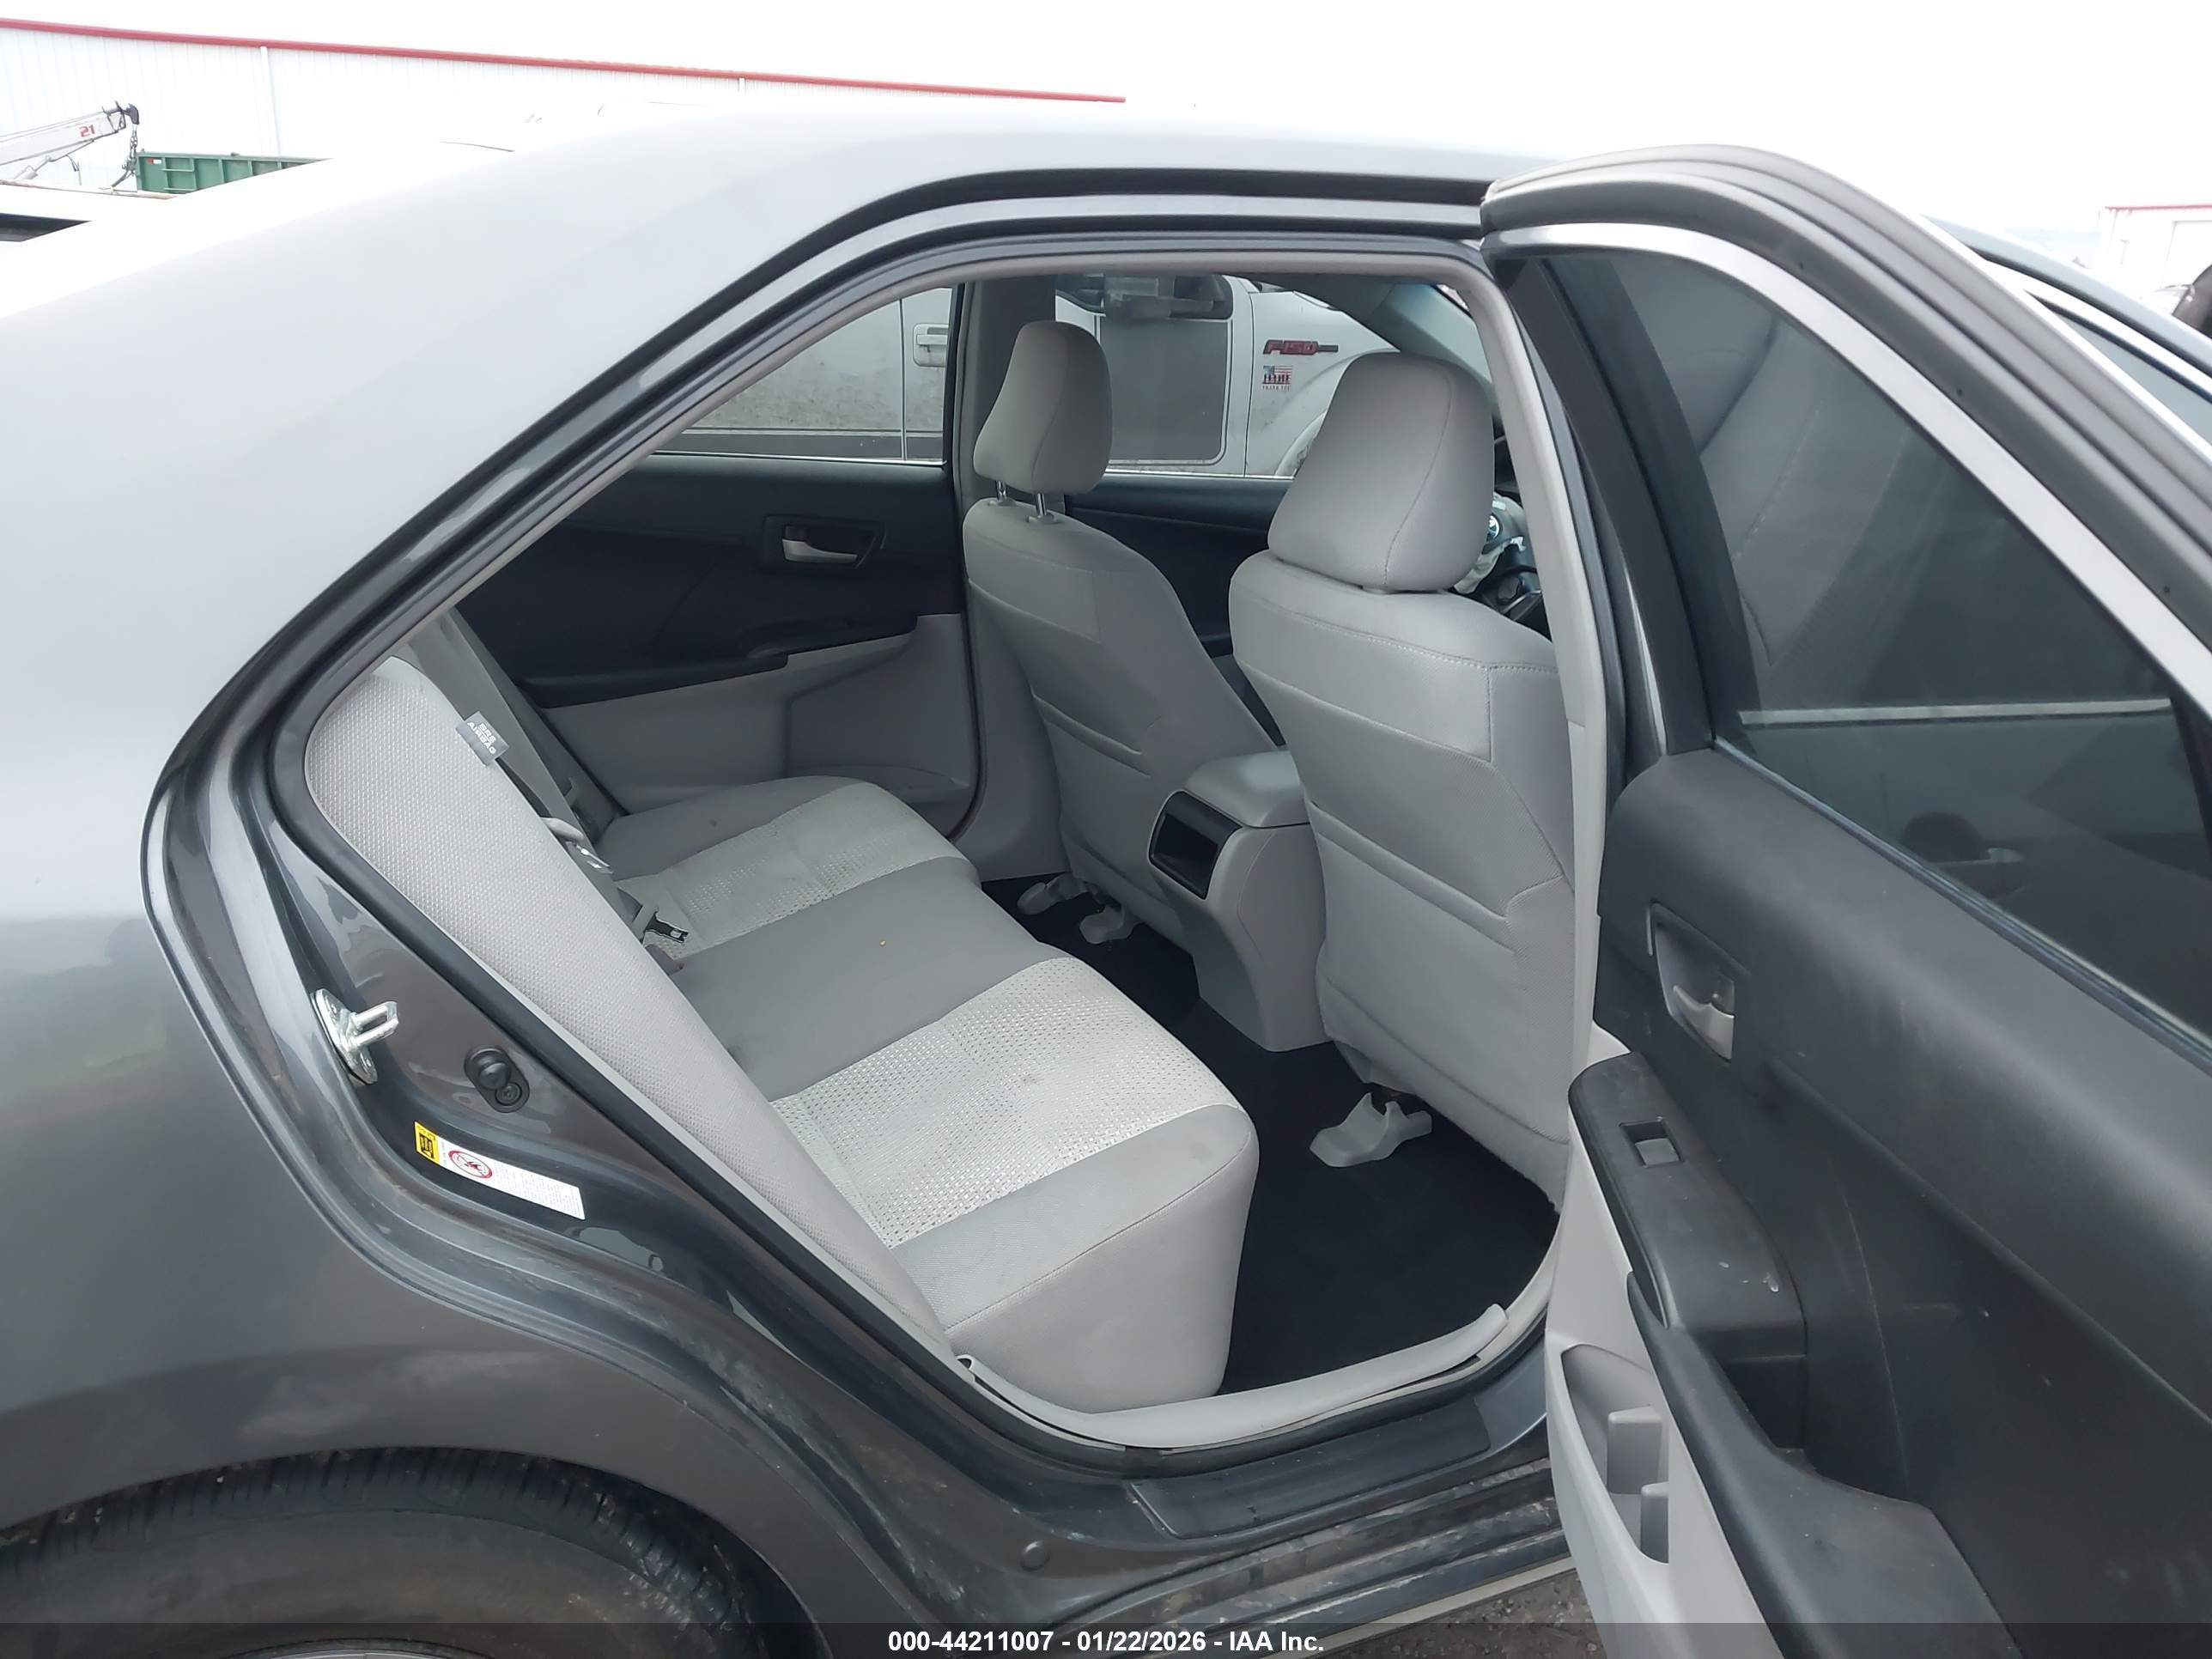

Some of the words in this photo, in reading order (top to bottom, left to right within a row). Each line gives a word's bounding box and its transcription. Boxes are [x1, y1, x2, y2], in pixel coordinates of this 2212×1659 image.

[80, 125, 94, 137] 21
[466, 722, 496, 754] AIRBAG
[478, 723, 496, 743] SRS
